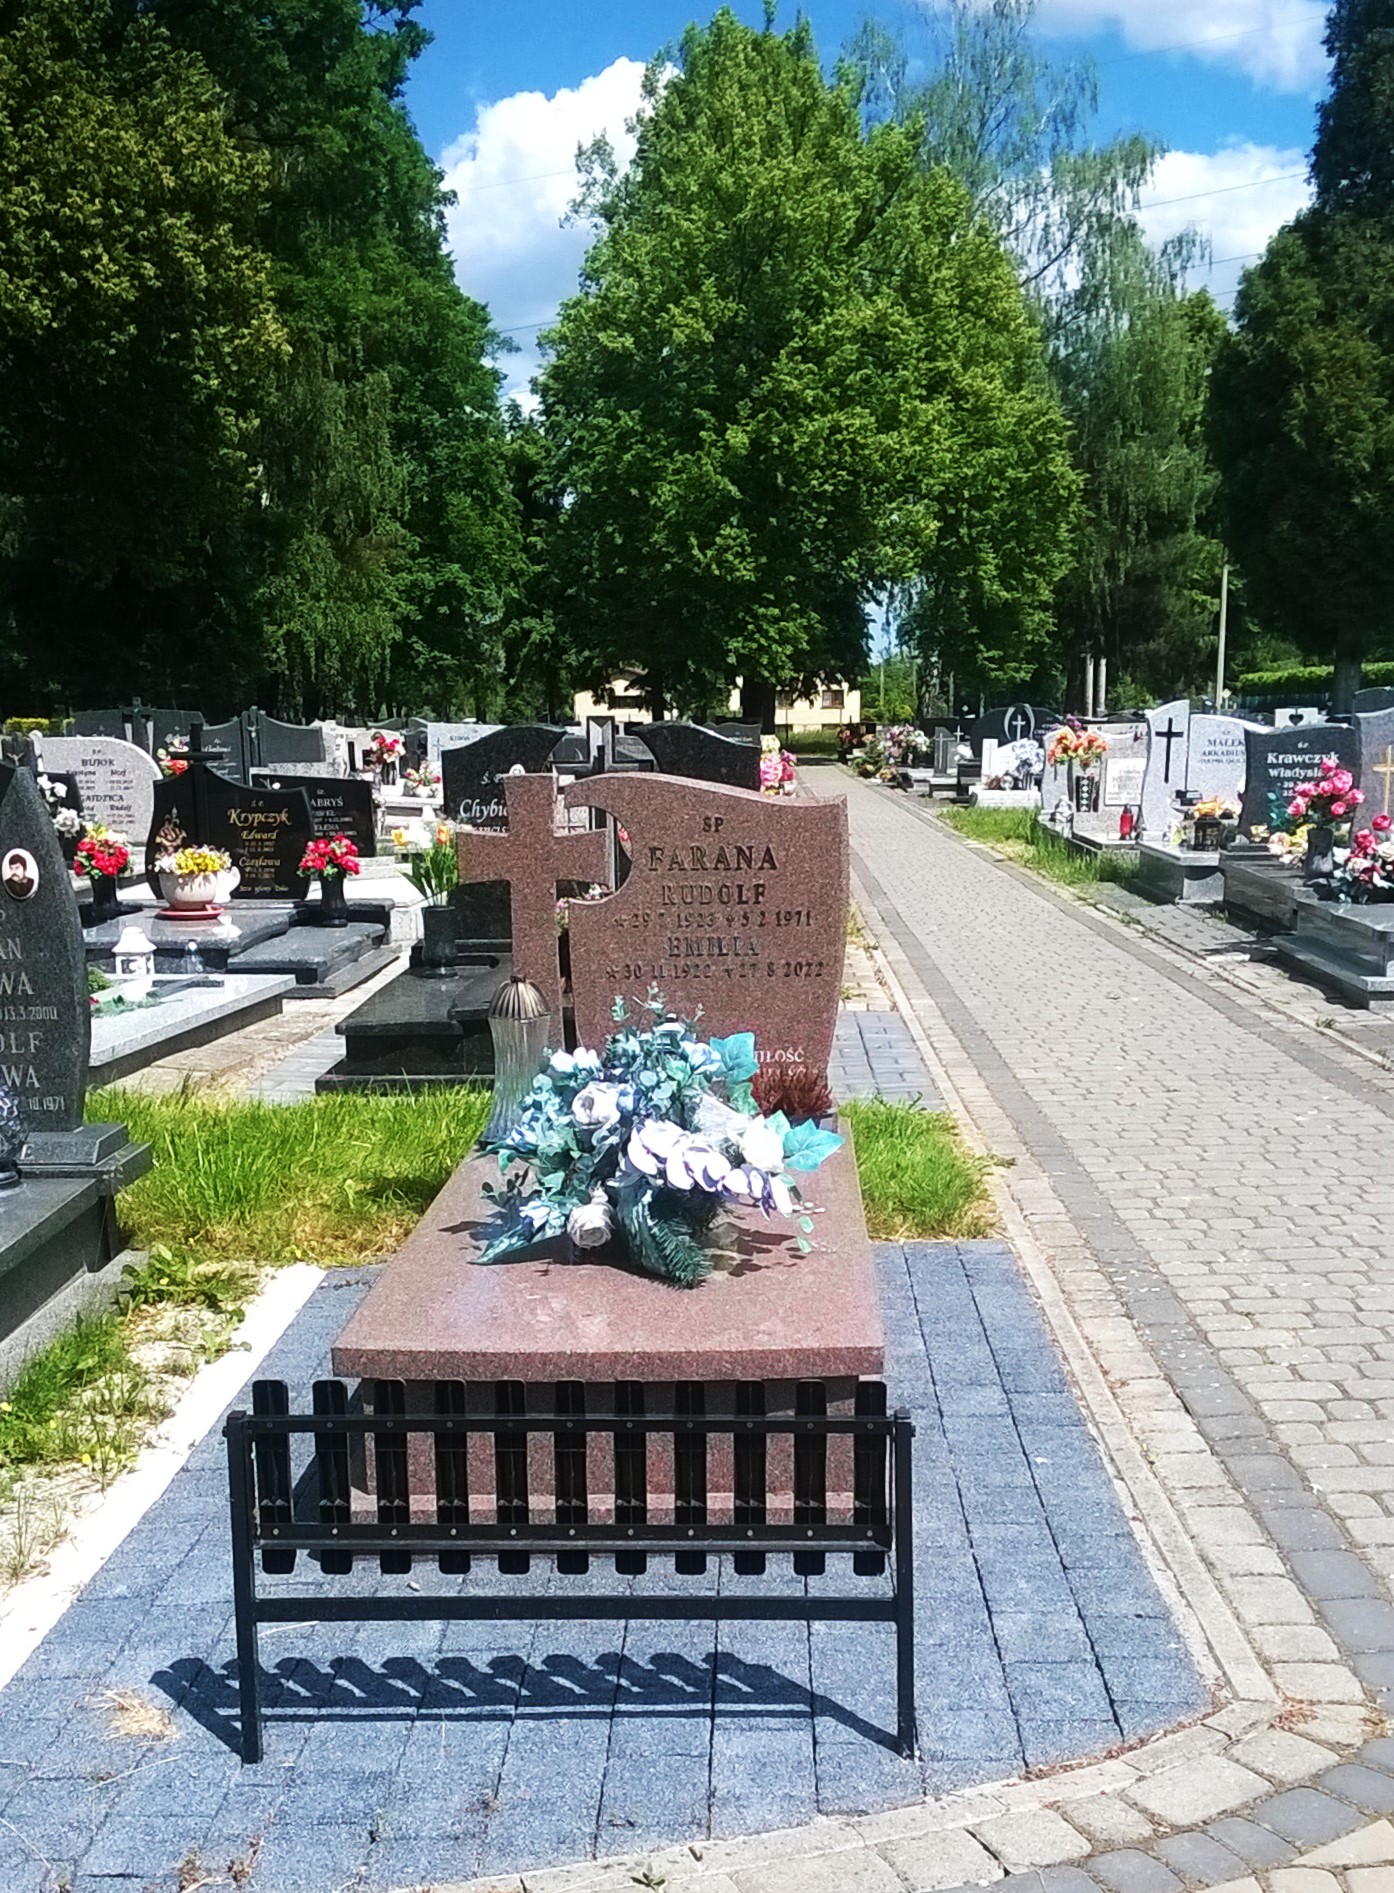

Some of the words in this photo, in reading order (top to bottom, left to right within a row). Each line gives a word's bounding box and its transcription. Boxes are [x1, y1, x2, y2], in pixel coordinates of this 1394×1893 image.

[310, 796, 344, 807] ABRYŚ
[227, 808, 292, 826] Krypczyk
[648, 844, 778, 872] FARANA
[661, 883, 767, 906] RUDOLF
[668, 935, 760, 958] EMILIA
